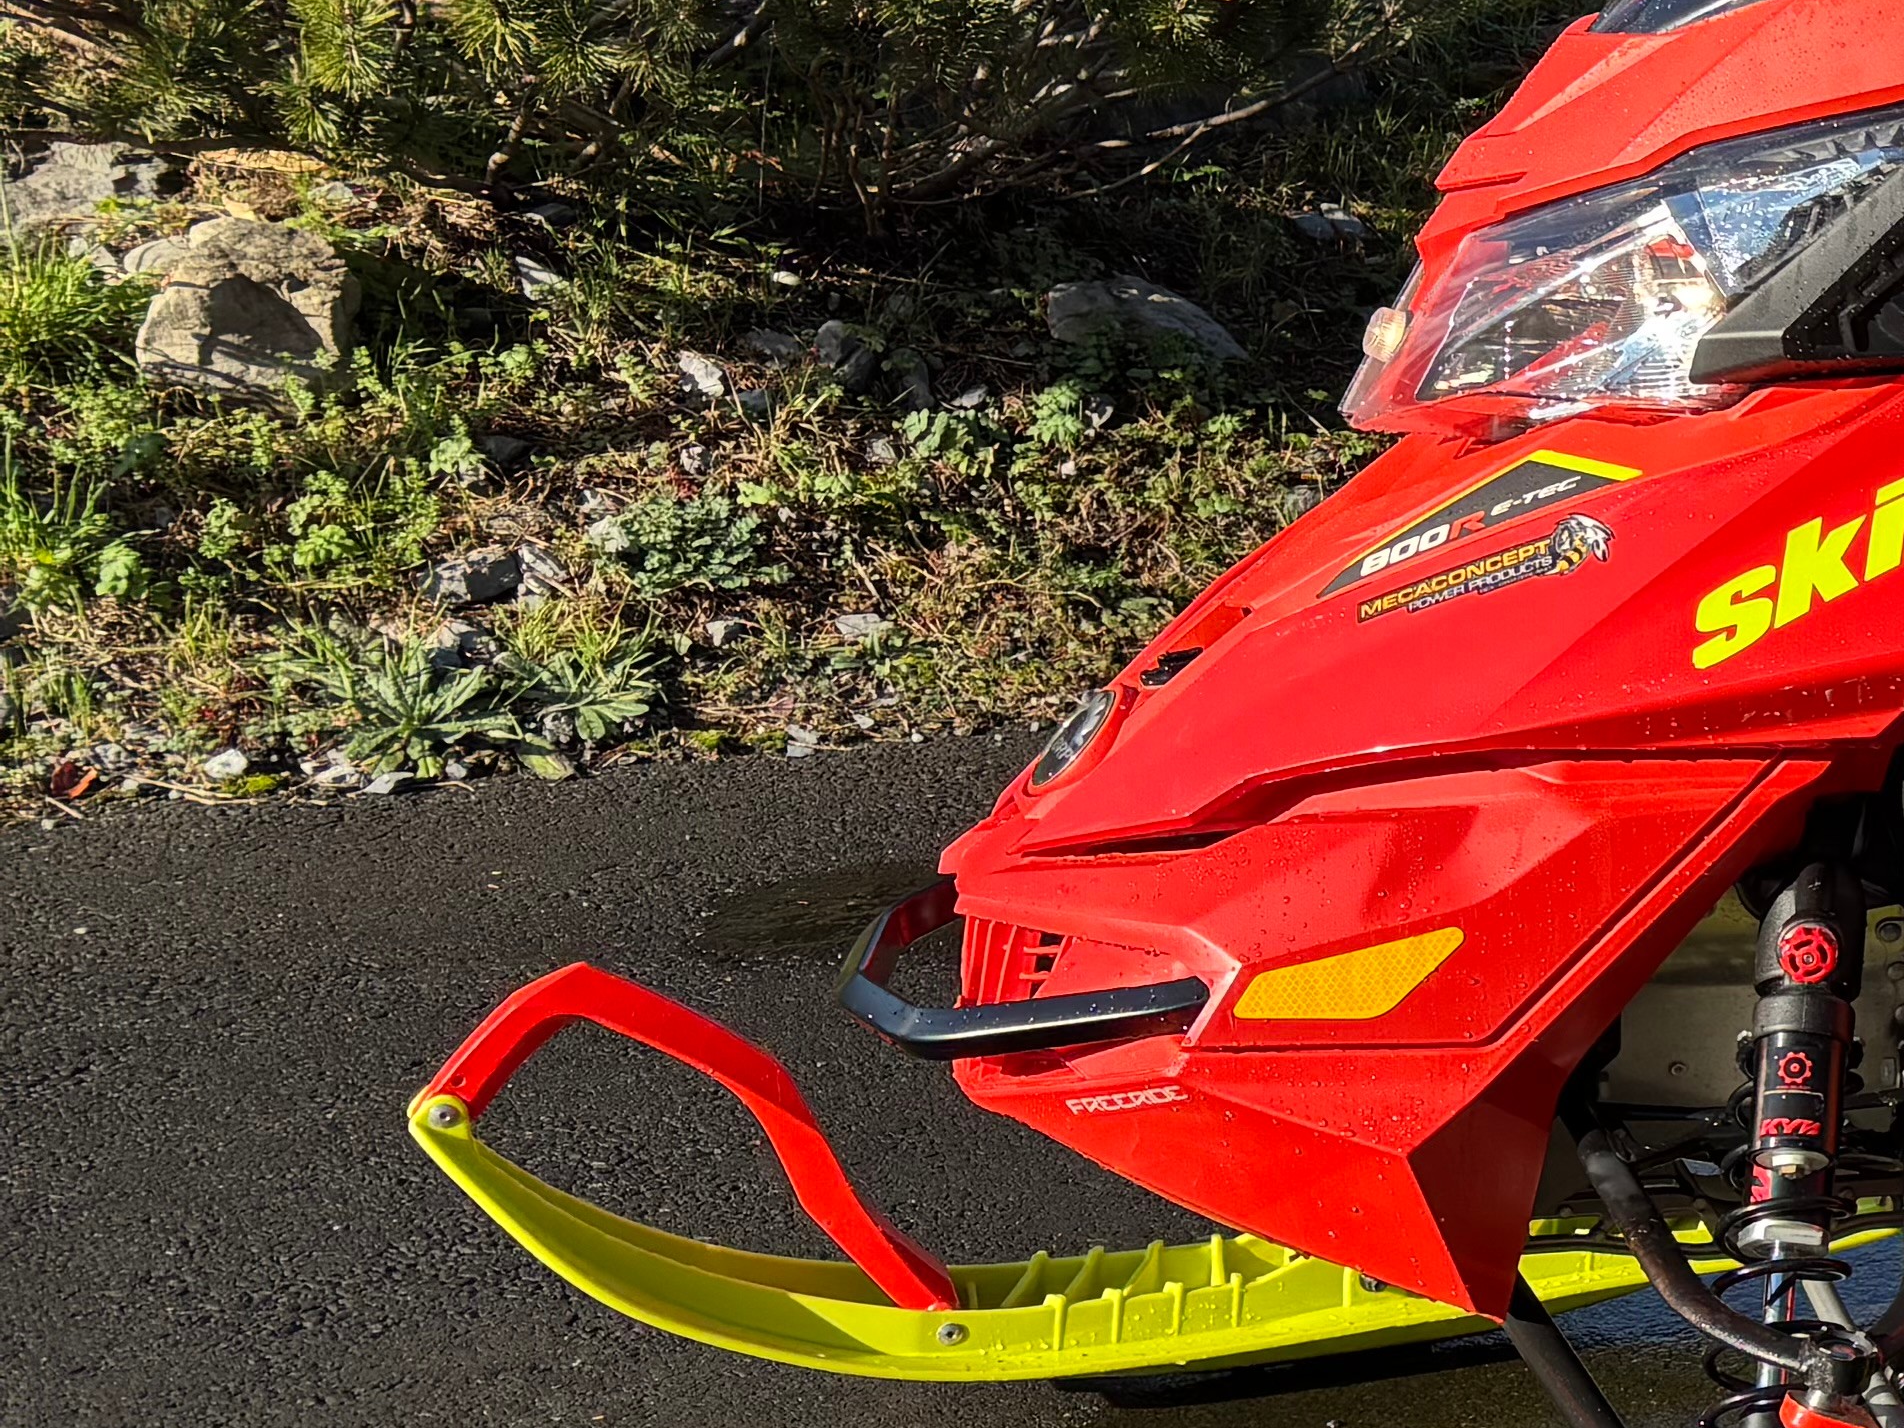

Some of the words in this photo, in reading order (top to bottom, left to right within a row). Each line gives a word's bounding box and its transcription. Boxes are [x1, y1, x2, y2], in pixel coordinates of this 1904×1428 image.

[1360, 510, 1486, 577] 800R
[1490, 475, 1581, 516] E-TEC
[1360, 538, 1551, 619] MECACONCEPT
[1408, 582, 1466, 612] POWER
[1468, 555, 1553, 592] PRODUCTS
[1065, 1085, 1189, 1115] FREERIDE
